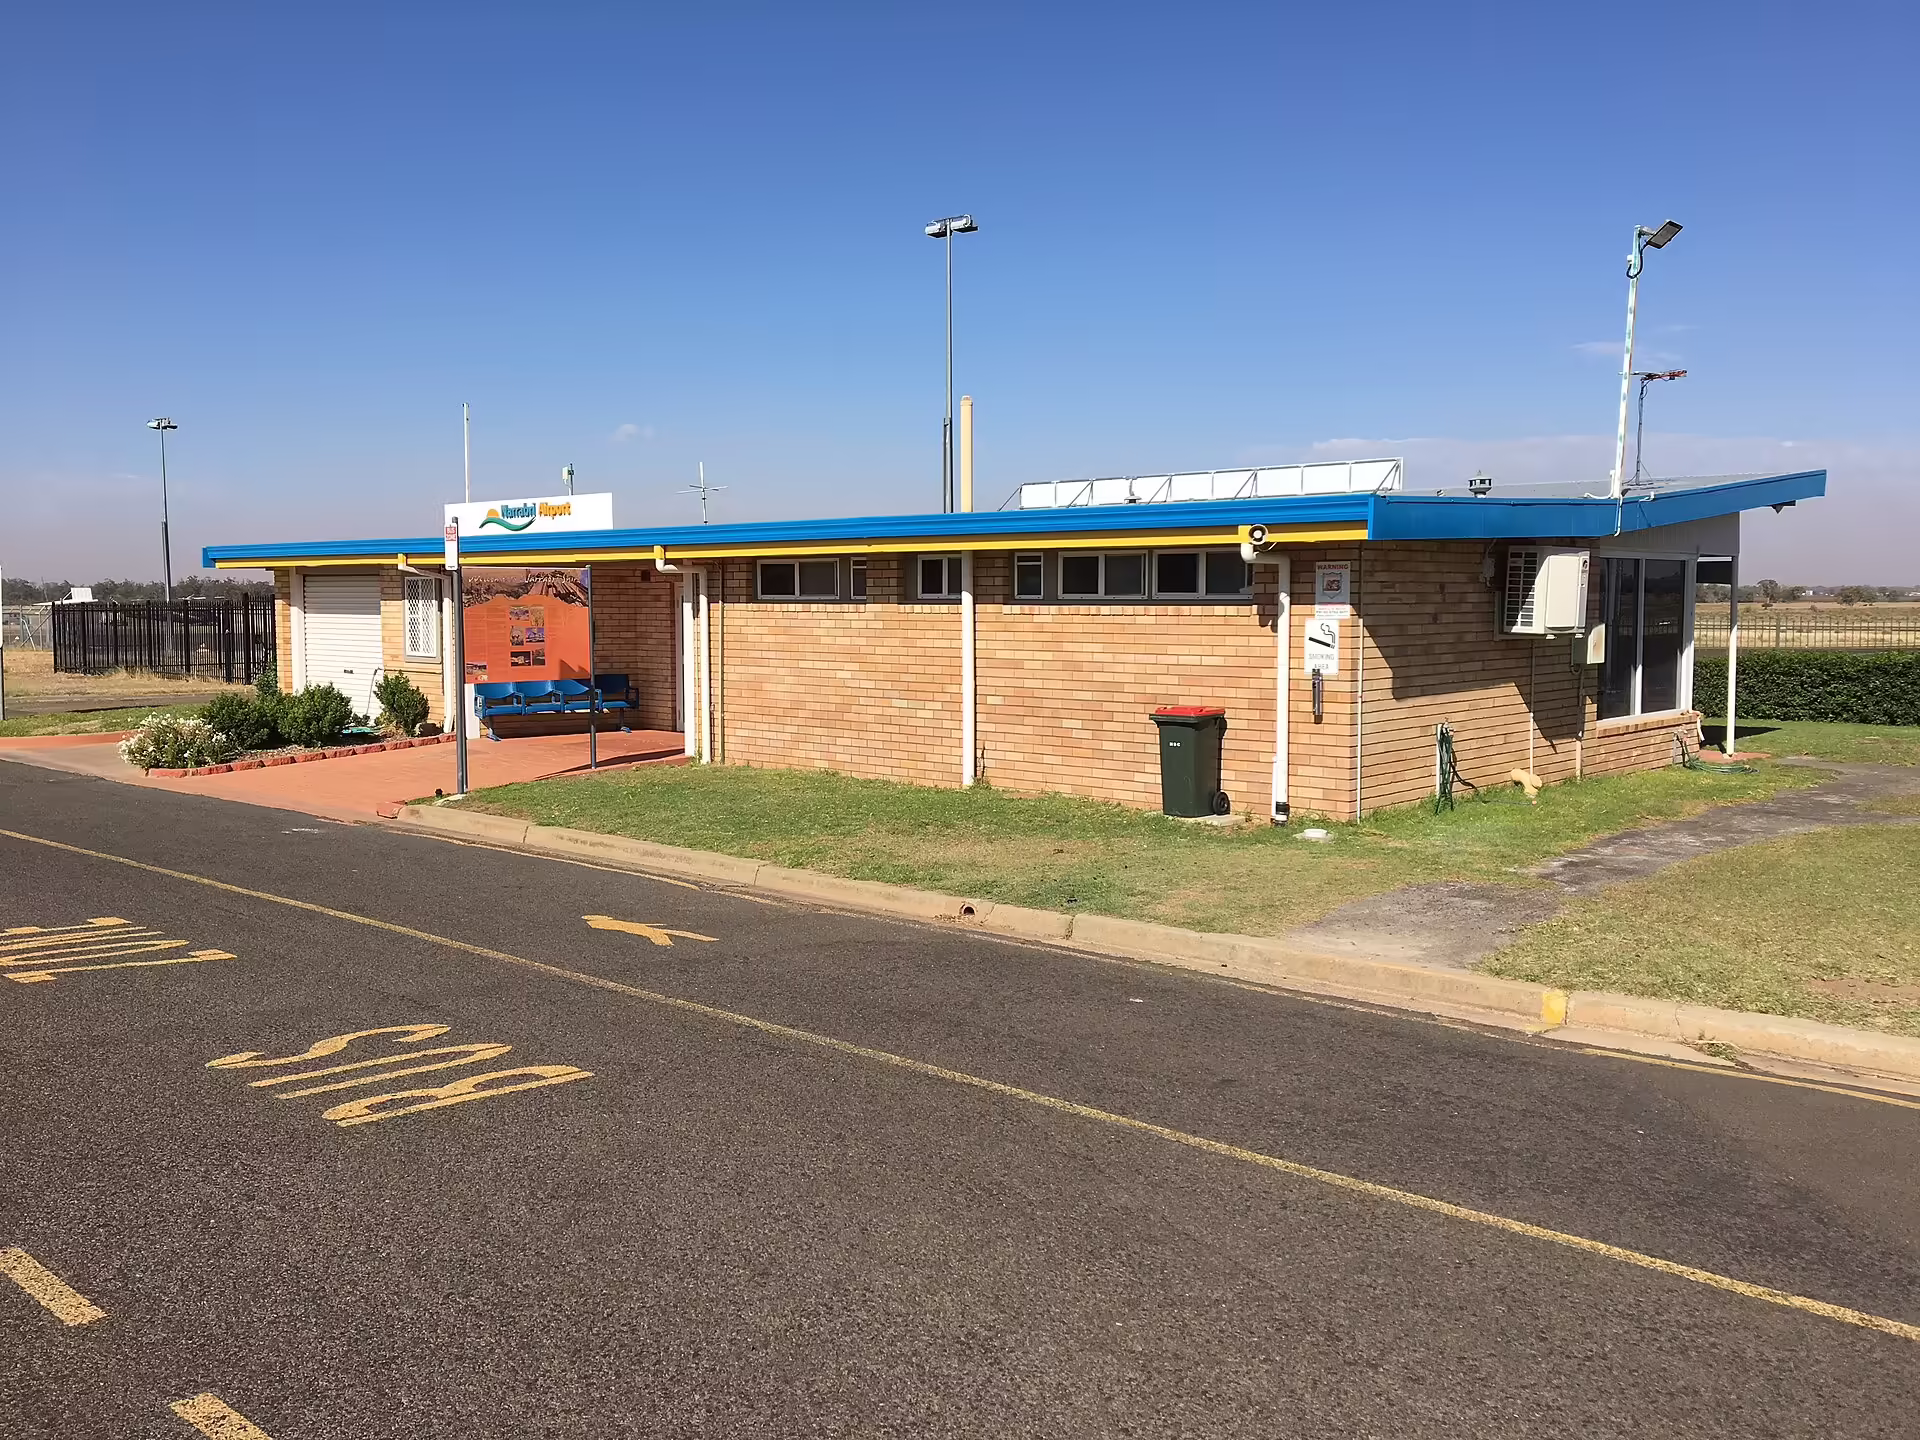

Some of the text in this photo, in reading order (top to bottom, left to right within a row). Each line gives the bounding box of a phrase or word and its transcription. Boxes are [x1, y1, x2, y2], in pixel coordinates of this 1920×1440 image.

[501, 502, 572, 520] Narrabri Airport
[205, 1023, 595, 1127] BUS
